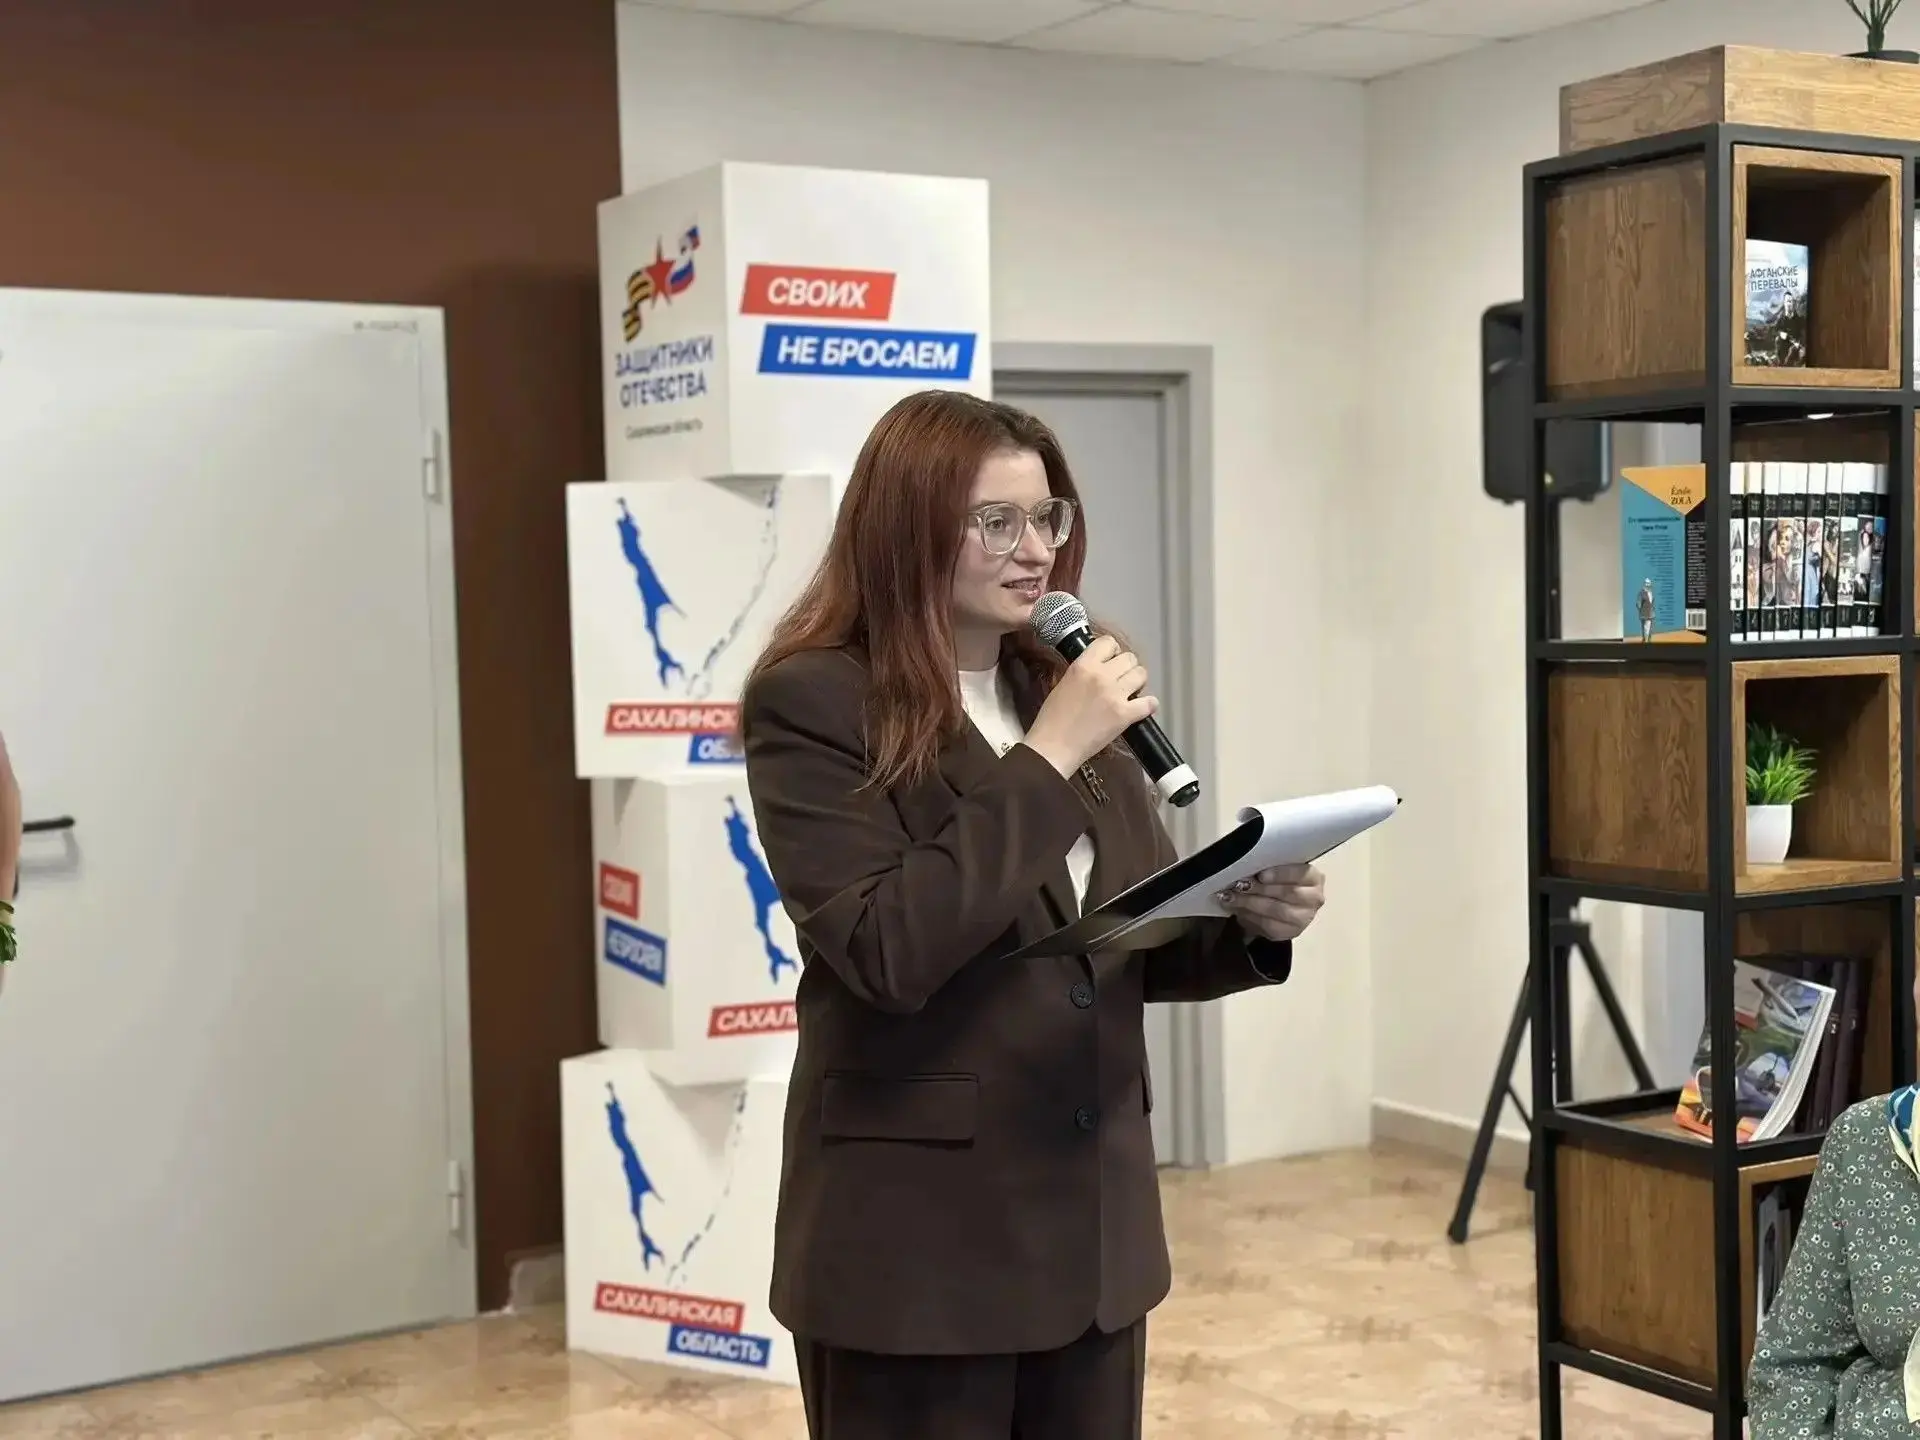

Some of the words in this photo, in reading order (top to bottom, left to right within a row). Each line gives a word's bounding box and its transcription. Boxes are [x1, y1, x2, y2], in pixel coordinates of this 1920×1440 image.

[1750, 265, 1799, 279] АФГАНСКИЕ
[1750, 278, 1798, 291] ПЕРЕВАЛЫ
[767, 277, 870, 309] СВОИХ
[615, 335, 713, 377] ЗАЩИТНИКИ
[777, 335, 819, 364] НЕ
[821, 337, 960, 370] БРОСАЕМ
[620, 369, 707, 408] ОТЕЧЕСТВА
[612, 708, 739, 730] САХАЛИНСК
[716, 1005, 798, 1032] САХАЛ
[602, 1287, 737, 1329] САХАЛИНСКАЯ
[675, 1330, 763, 1362] ОБЛАСТЬ
